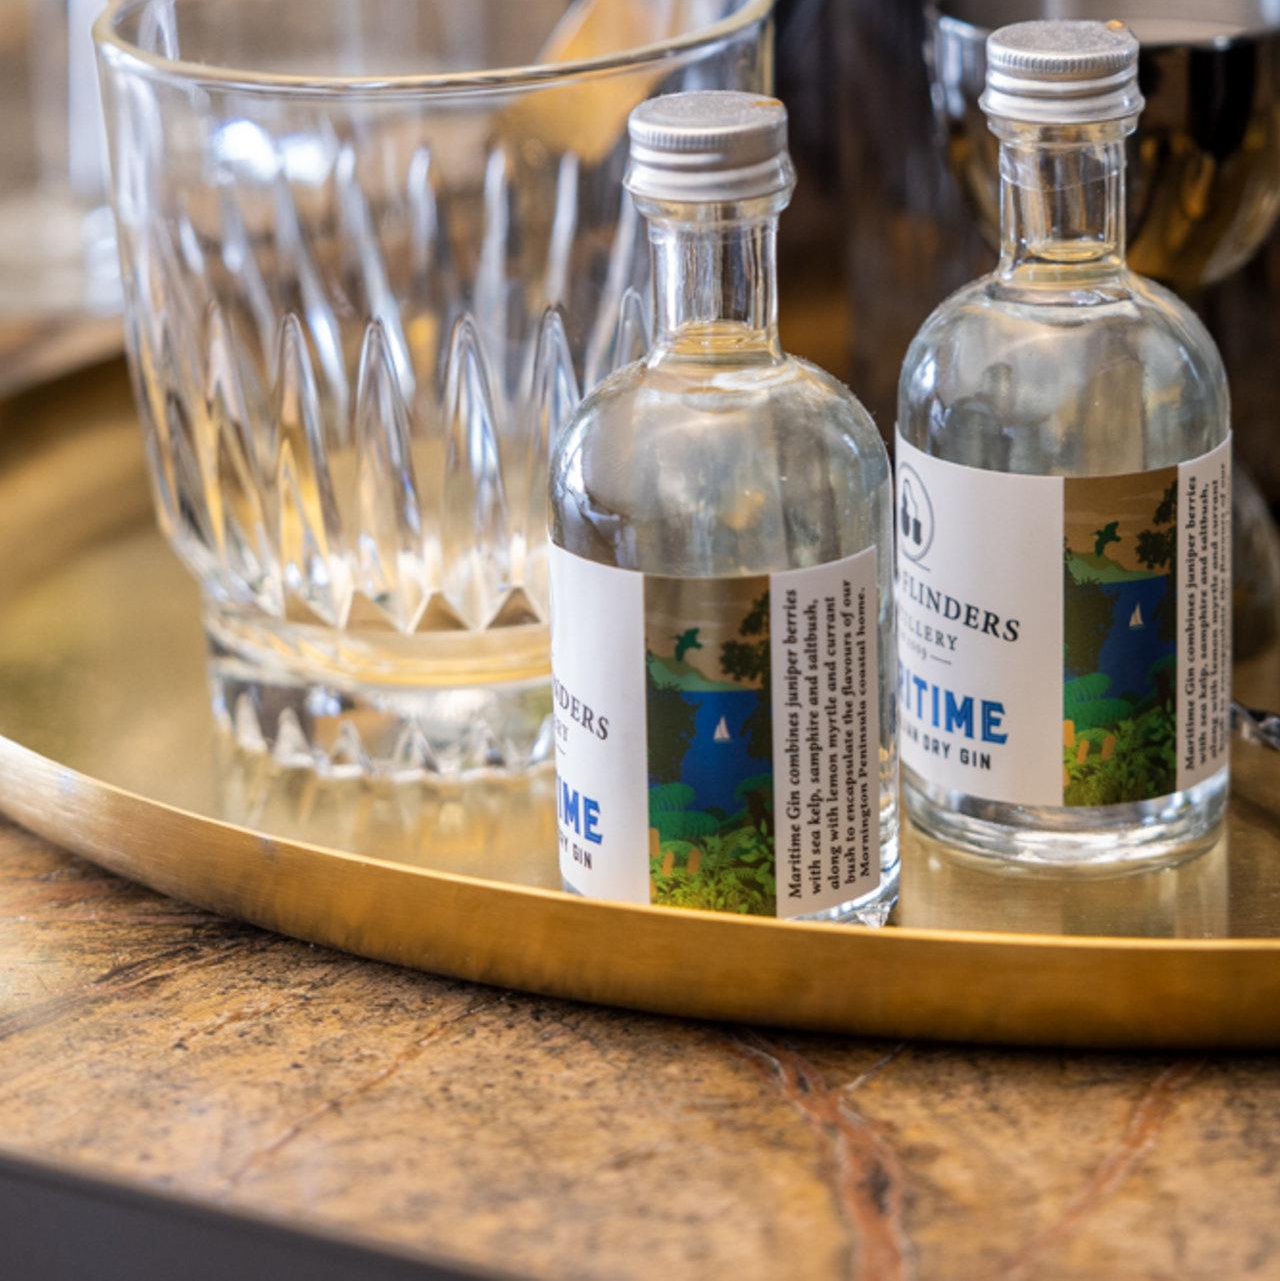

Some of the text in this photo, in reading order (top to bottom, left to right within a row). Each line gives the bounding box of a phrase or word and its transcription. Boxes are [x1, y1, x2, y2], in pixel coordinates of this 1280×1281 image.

[782, 589, 802, 899] Maritime Gin combines juniper berries
[803, 599, 824, 895] with sea kelp, samphire and saltbush,
[823, 597, 842, 890] along with lemon myrtle and currant
[840, 579, 857, 885] bush to encapsulate the flavours of our
[856, 587, 871, 877] Mornington Peninsula coastal home.
[901, 570, 1021, 643] FLINDERS
[923, 733, 991, 771] DRY GIN
[1185, 476, 1198, 770] Maritime Gin combines juniper berries
[1198, 483, 1209, 765] with sea kelp, samphire and saltbush,
[572, 842, 592, 870] GIN
